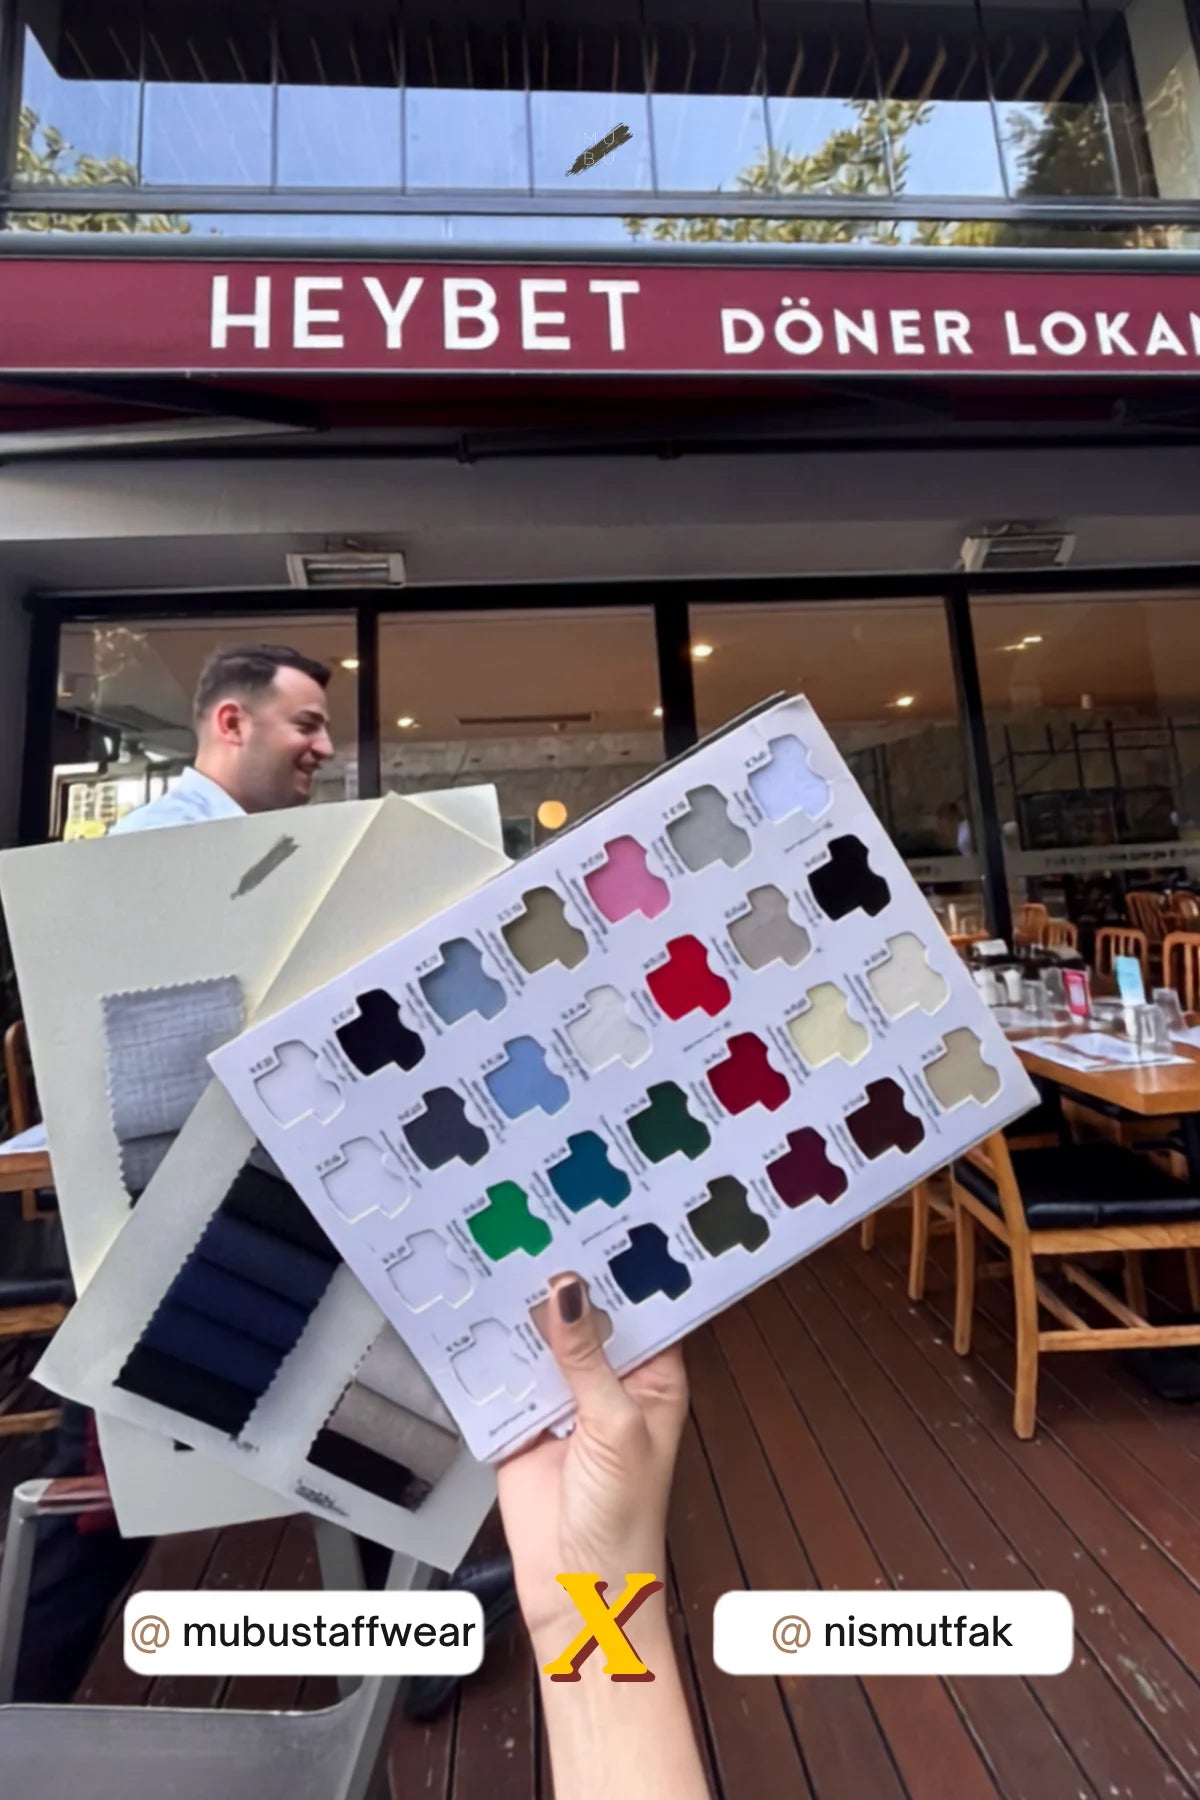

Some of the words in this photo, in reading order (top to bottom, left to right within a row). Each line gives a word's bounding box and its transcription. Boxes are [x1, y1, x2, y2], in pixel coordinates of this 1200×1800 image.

[210, 275, 640, 351] HEYBET
[721, 296, 974, 356] DÖNER
[1004, 310, 1200, 356] LOKA
